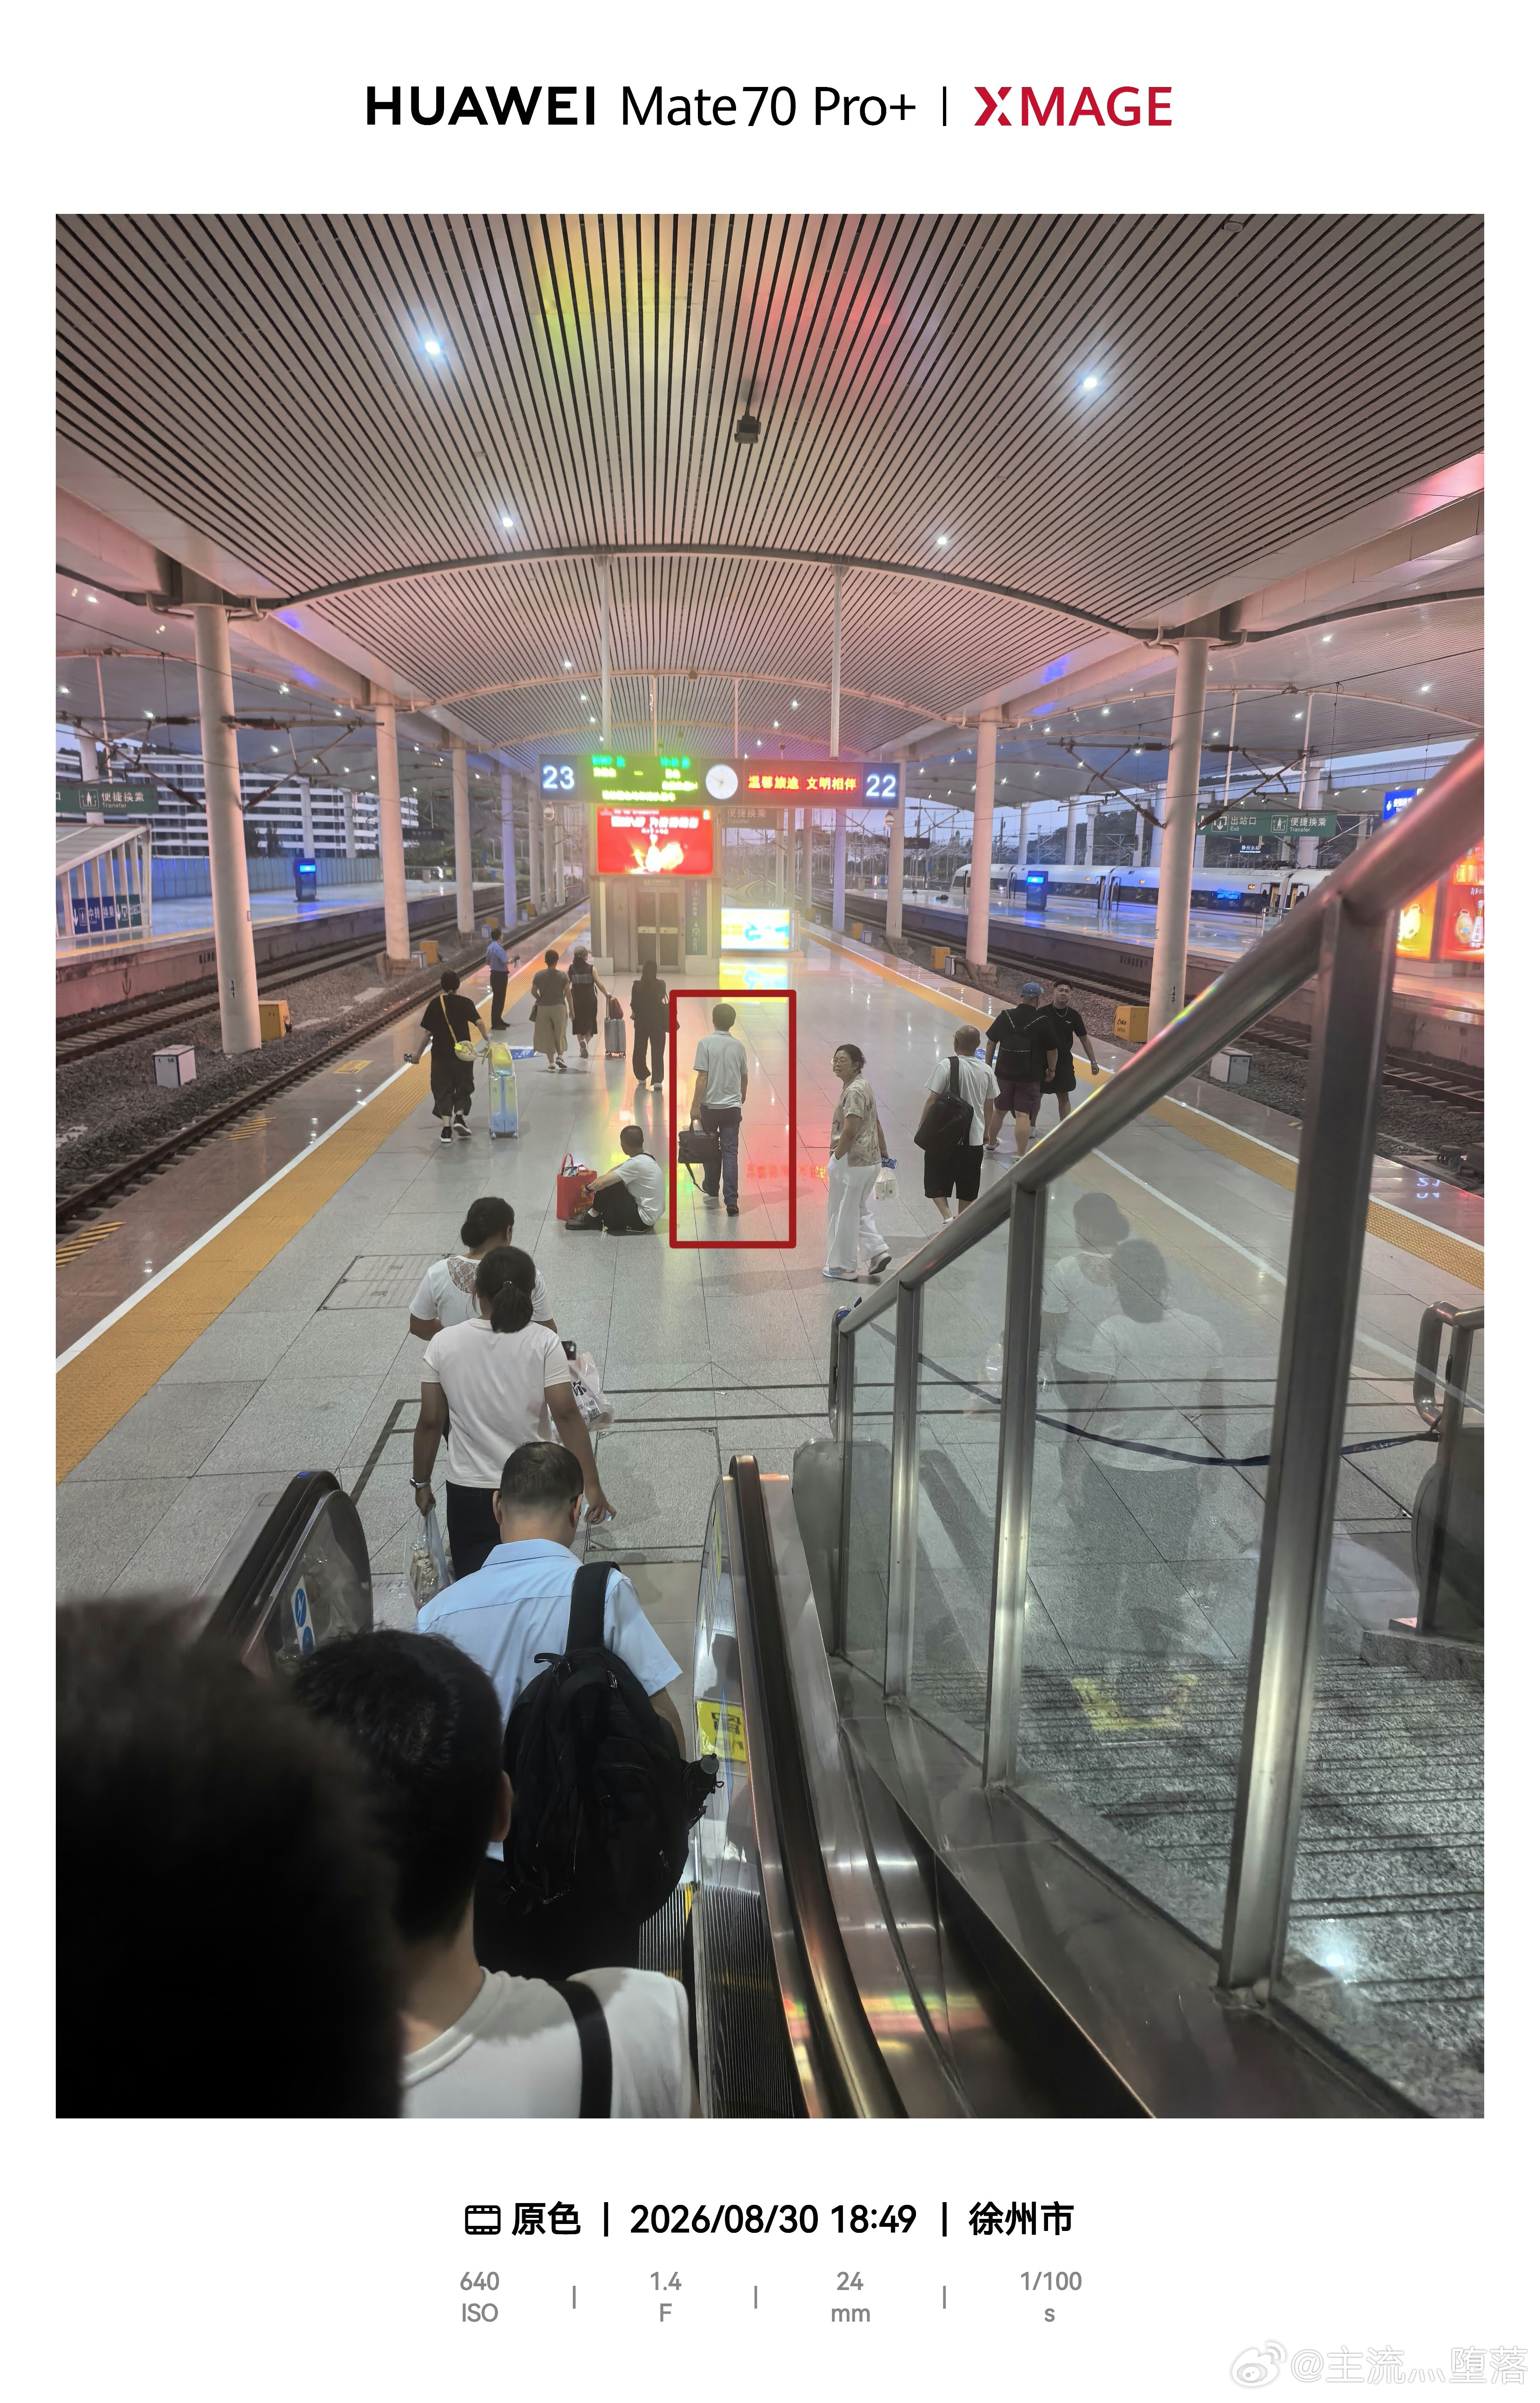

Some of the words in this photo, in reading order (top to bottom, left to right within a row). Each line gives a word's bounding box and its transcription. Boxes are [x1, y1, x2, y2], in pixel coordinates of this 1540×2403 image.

[543, 765, 575, 790] 23
[806, 776, 857, 791] 文明相伴
[866, 774, 896, 797] 22
[727, 808, 766, 818] 便捷换乘
[1230, 816, 1256, 825] 出站口
[1290, 817, 1326, 827] 便捷换乘
